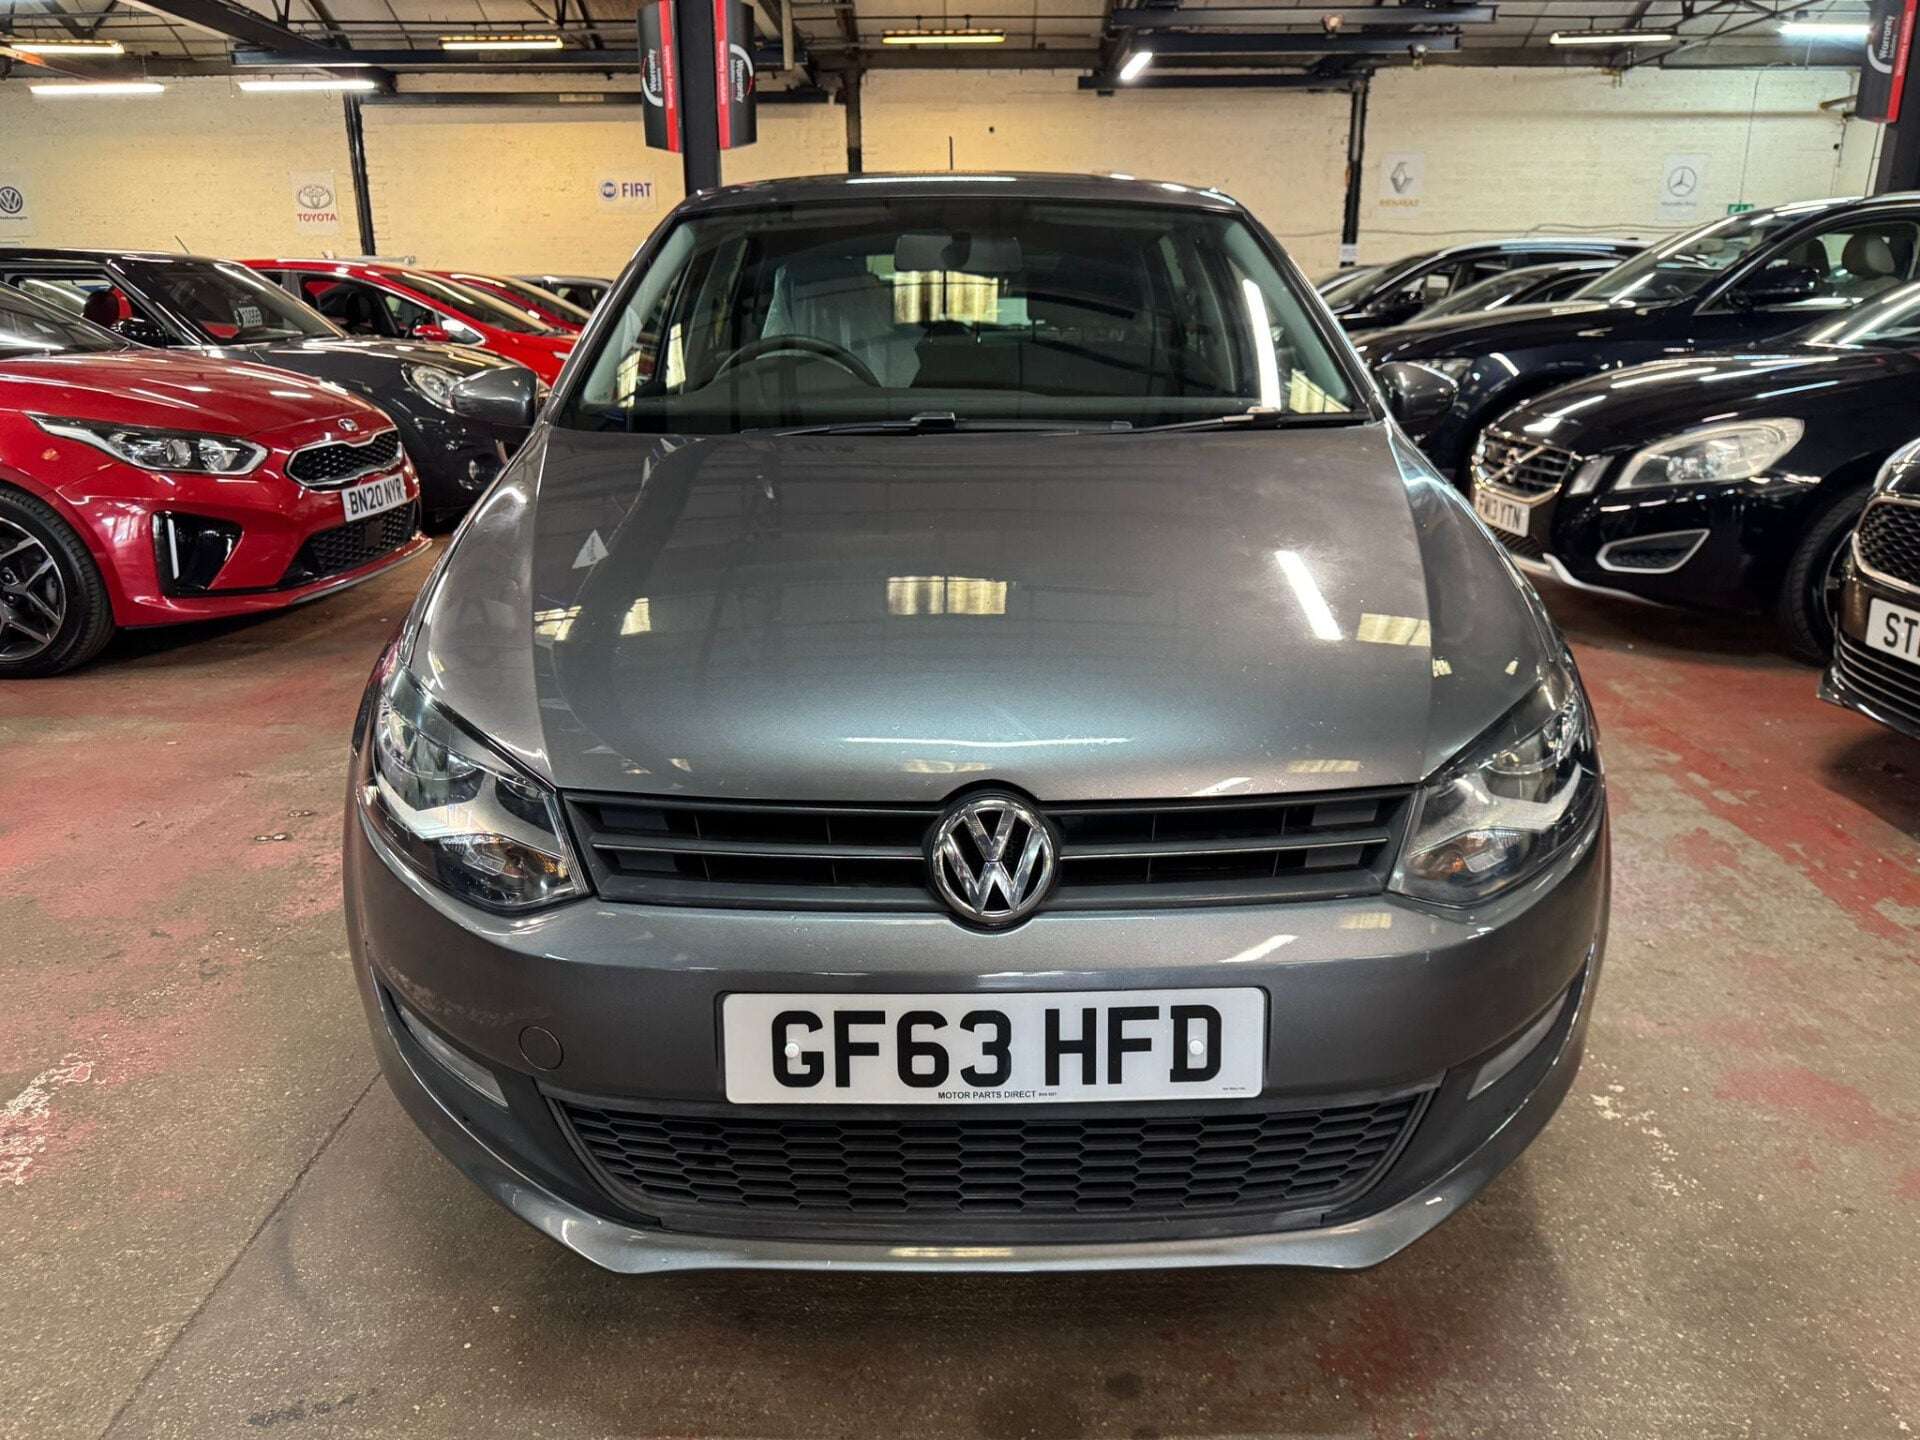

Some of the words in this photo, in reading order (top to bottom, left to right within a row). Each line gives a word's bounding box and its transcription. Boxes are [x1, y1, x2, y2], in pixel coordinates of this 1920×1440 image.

[1878, 15, 1896, 59] Warranty
[648, 48, 657, 93] Warranty
[735, 59, 745, 103] Warranty
[622, 182, 652, 197] FIAT
[297, 213, 336, 222] TOYOTA
[349, 484, 385, 514] BN20
[384, 478, 404, 504] NYR
[1883, 612, 1920, 658] ST
[771, 1010, 1012, 1088] GF63
[1044, 1004, 1222, 1086] HFD
[938, 1091, 971, 1099] MOTOR
[973, 1091, 1002, 1099] PARTS
[1004, 1090, 1037, 1098] DIRECT
